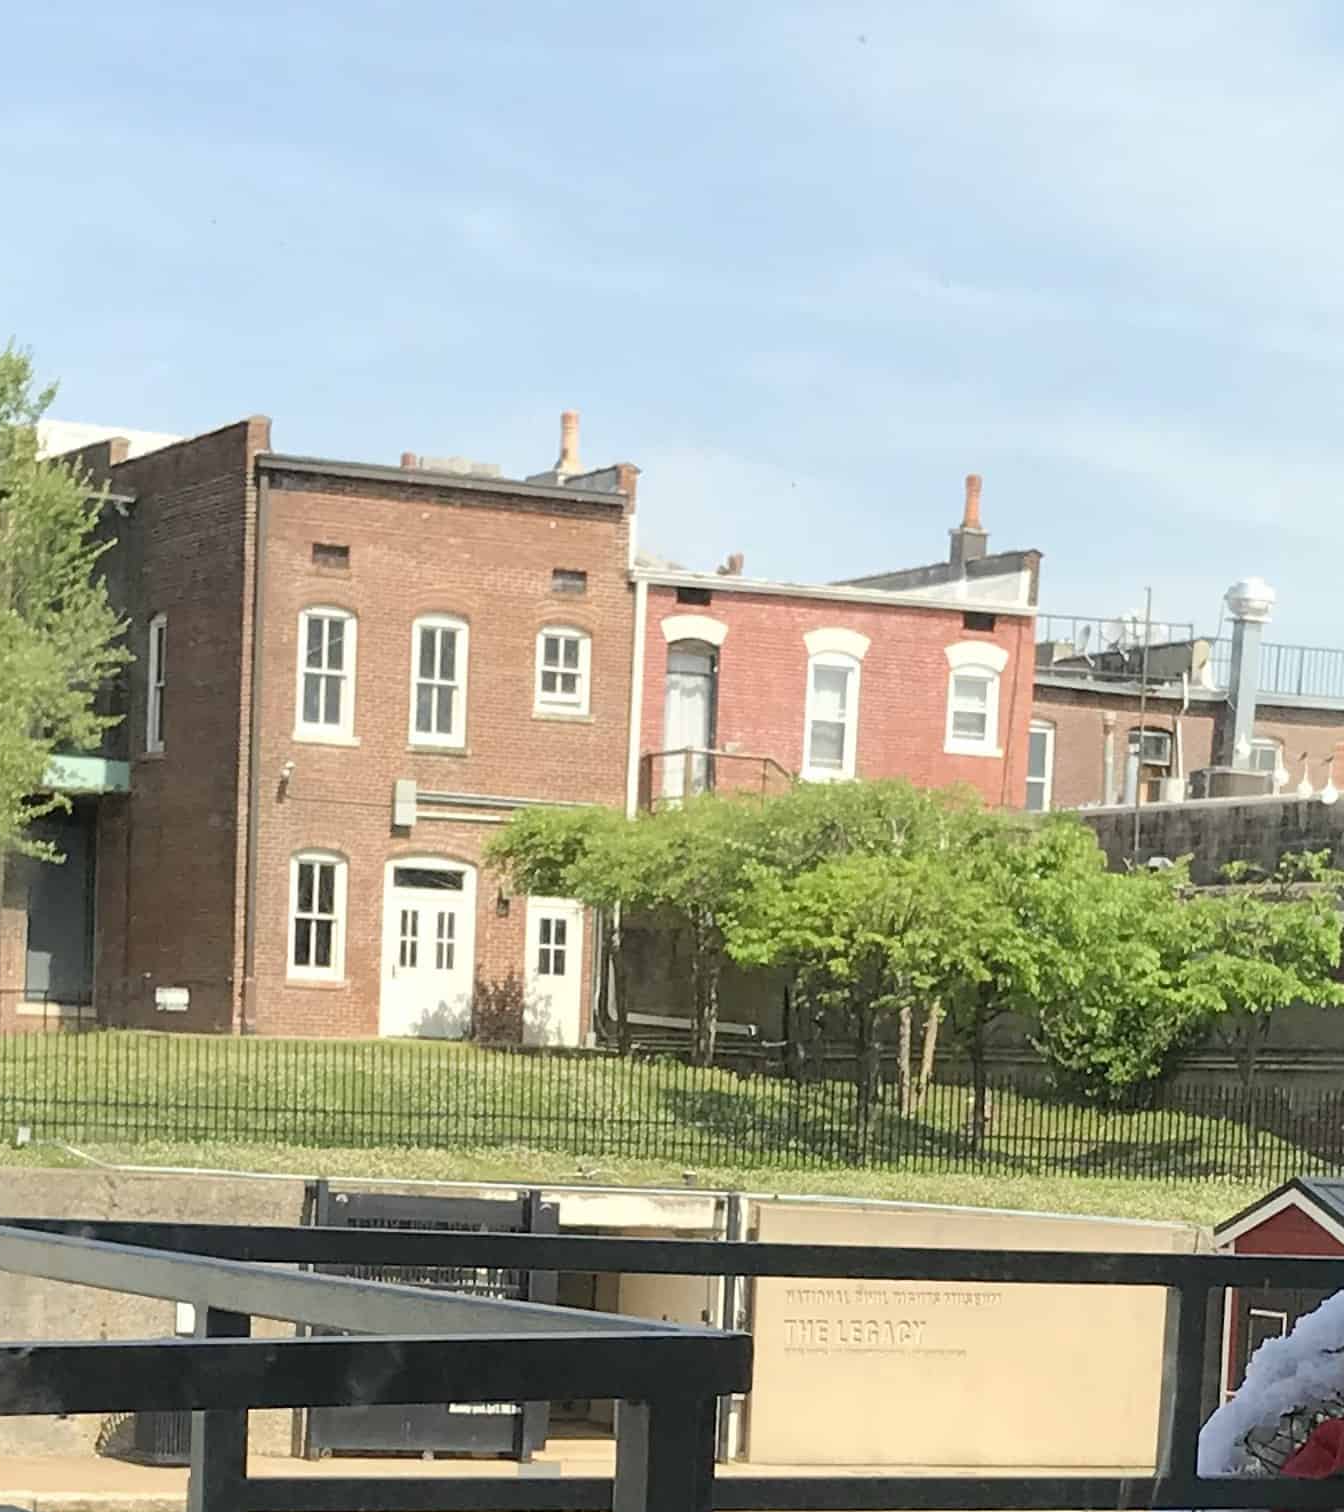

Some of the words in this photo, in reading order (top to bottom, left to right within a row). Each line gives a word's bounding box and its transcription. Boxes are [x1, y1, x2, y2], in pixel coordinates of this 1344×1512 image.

[784, 1289, 850, 1305] NATIONAL
[783, 1318, 829, 1345] THE
[837, 1318, 928, 1345] LEGACY
